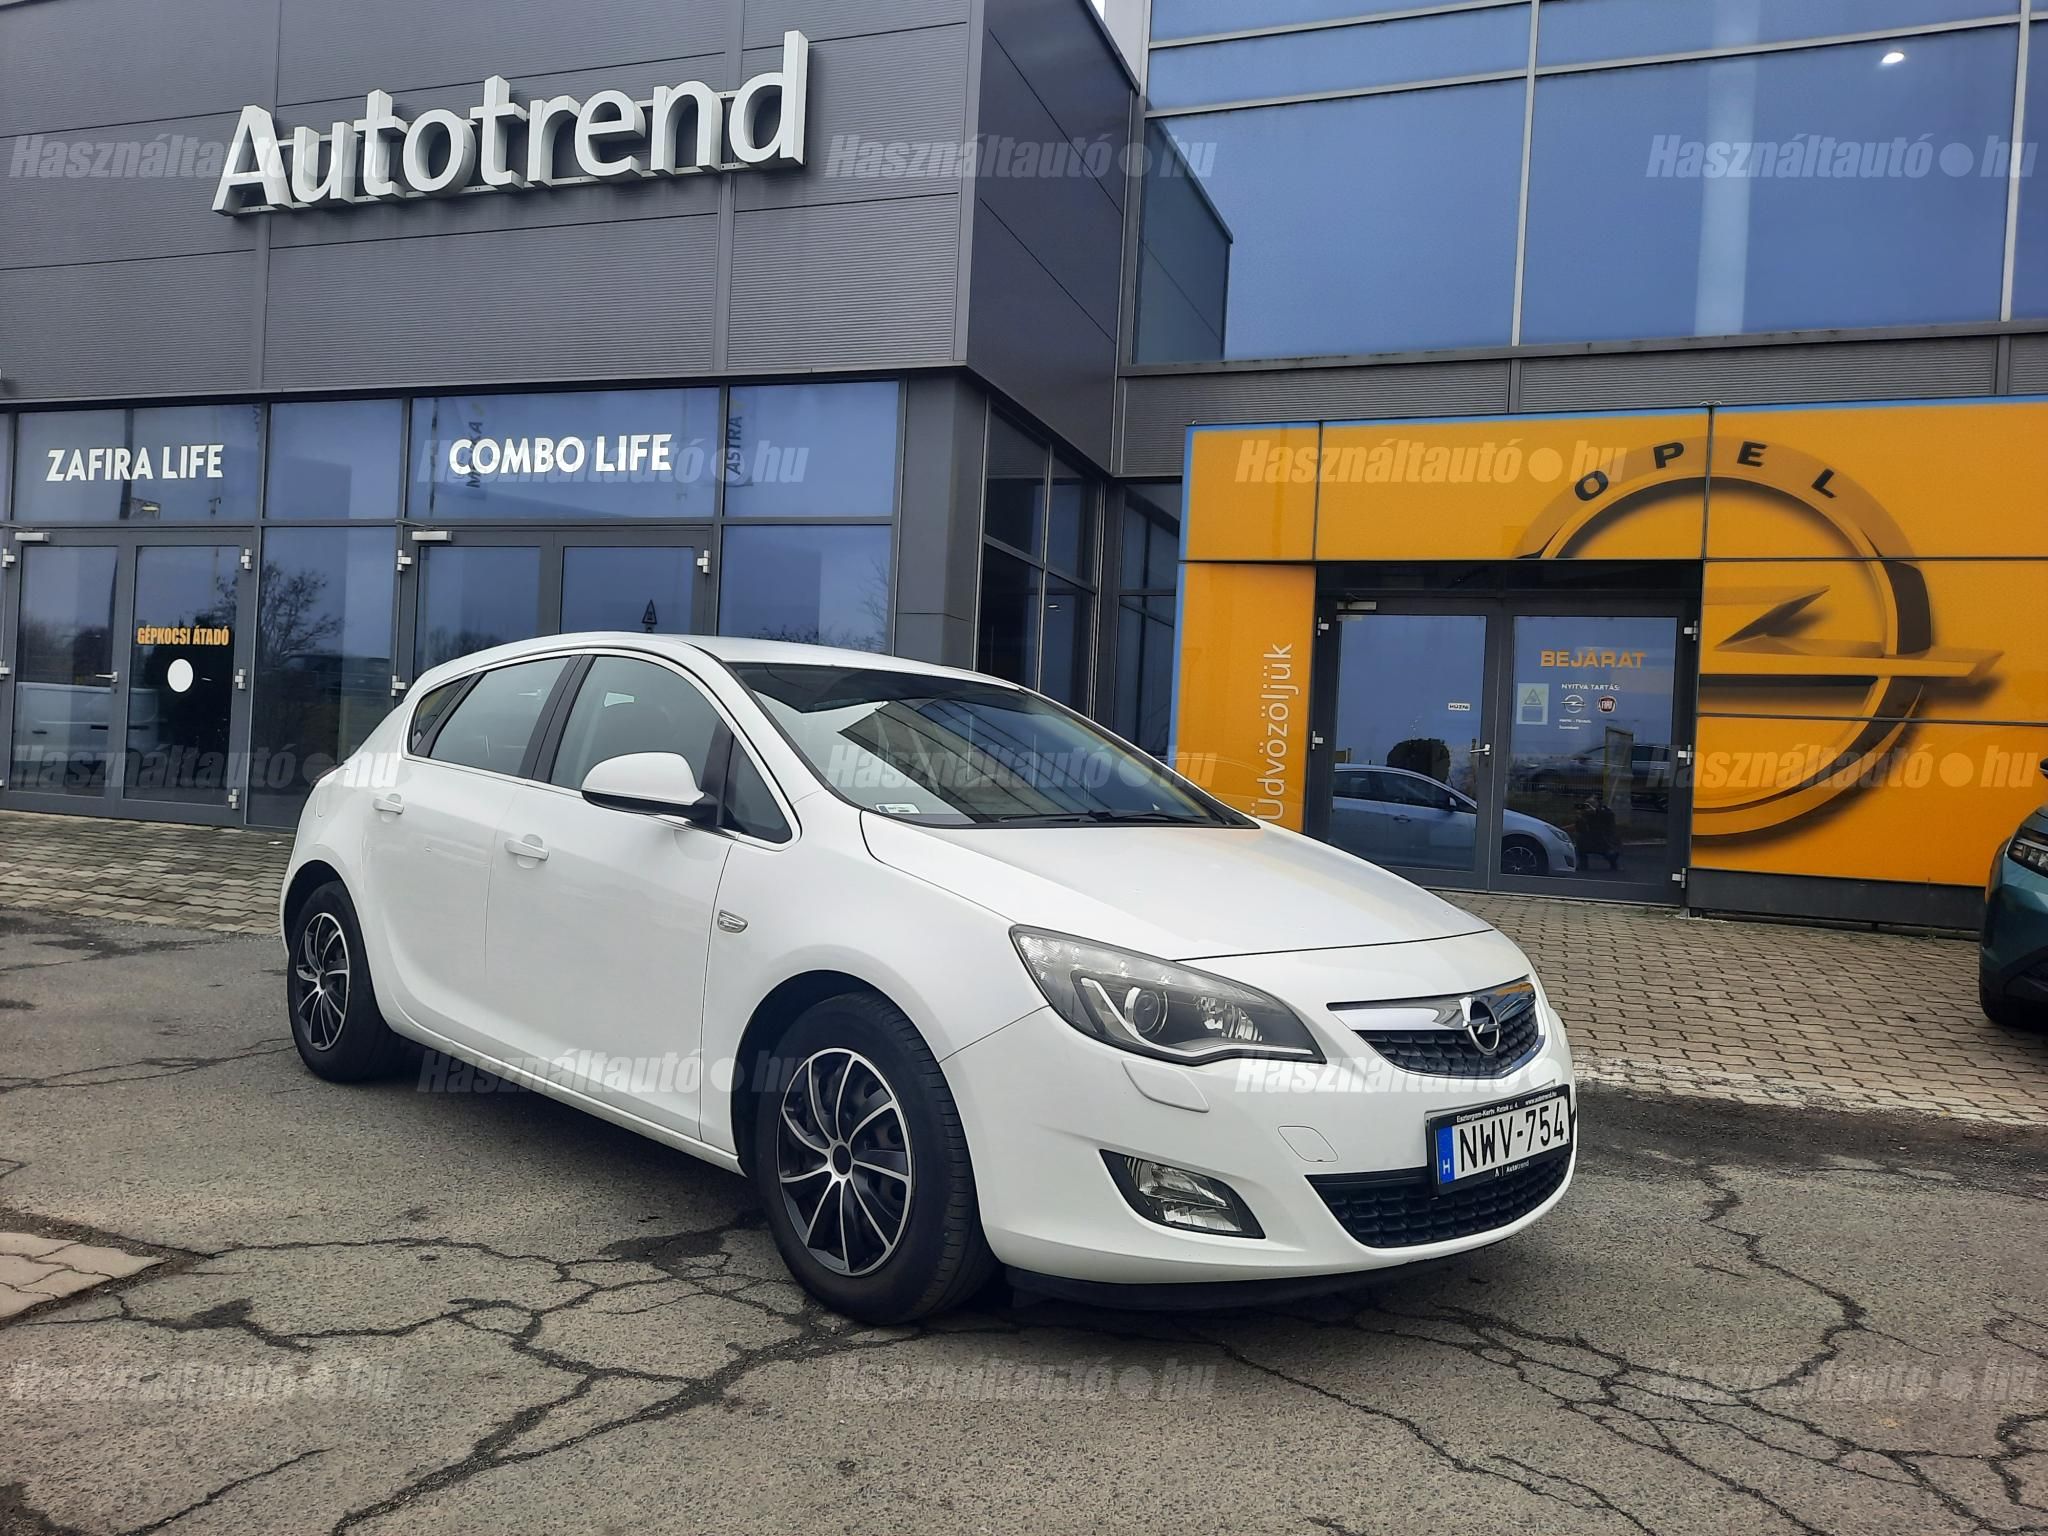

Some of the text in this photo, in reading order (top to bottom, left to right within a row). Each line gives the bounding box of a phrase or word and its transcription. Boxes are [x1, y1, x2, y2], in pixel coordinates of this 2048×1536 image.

[212, 30, 809, 216] Autotrend
[46, 444, 224, 482] ZAFIRA LIFE
[449, 433, 672, 475] COMBO LIFE
[1574, 441, 1837, 501] OPEL
[137, 624, 230, 646] GÉPKOCSI ÁTADÓ
[1251, 643, 1300, 820] Üdvözöljük
[1442, 1101, 1564, 1175] H NWV-754
